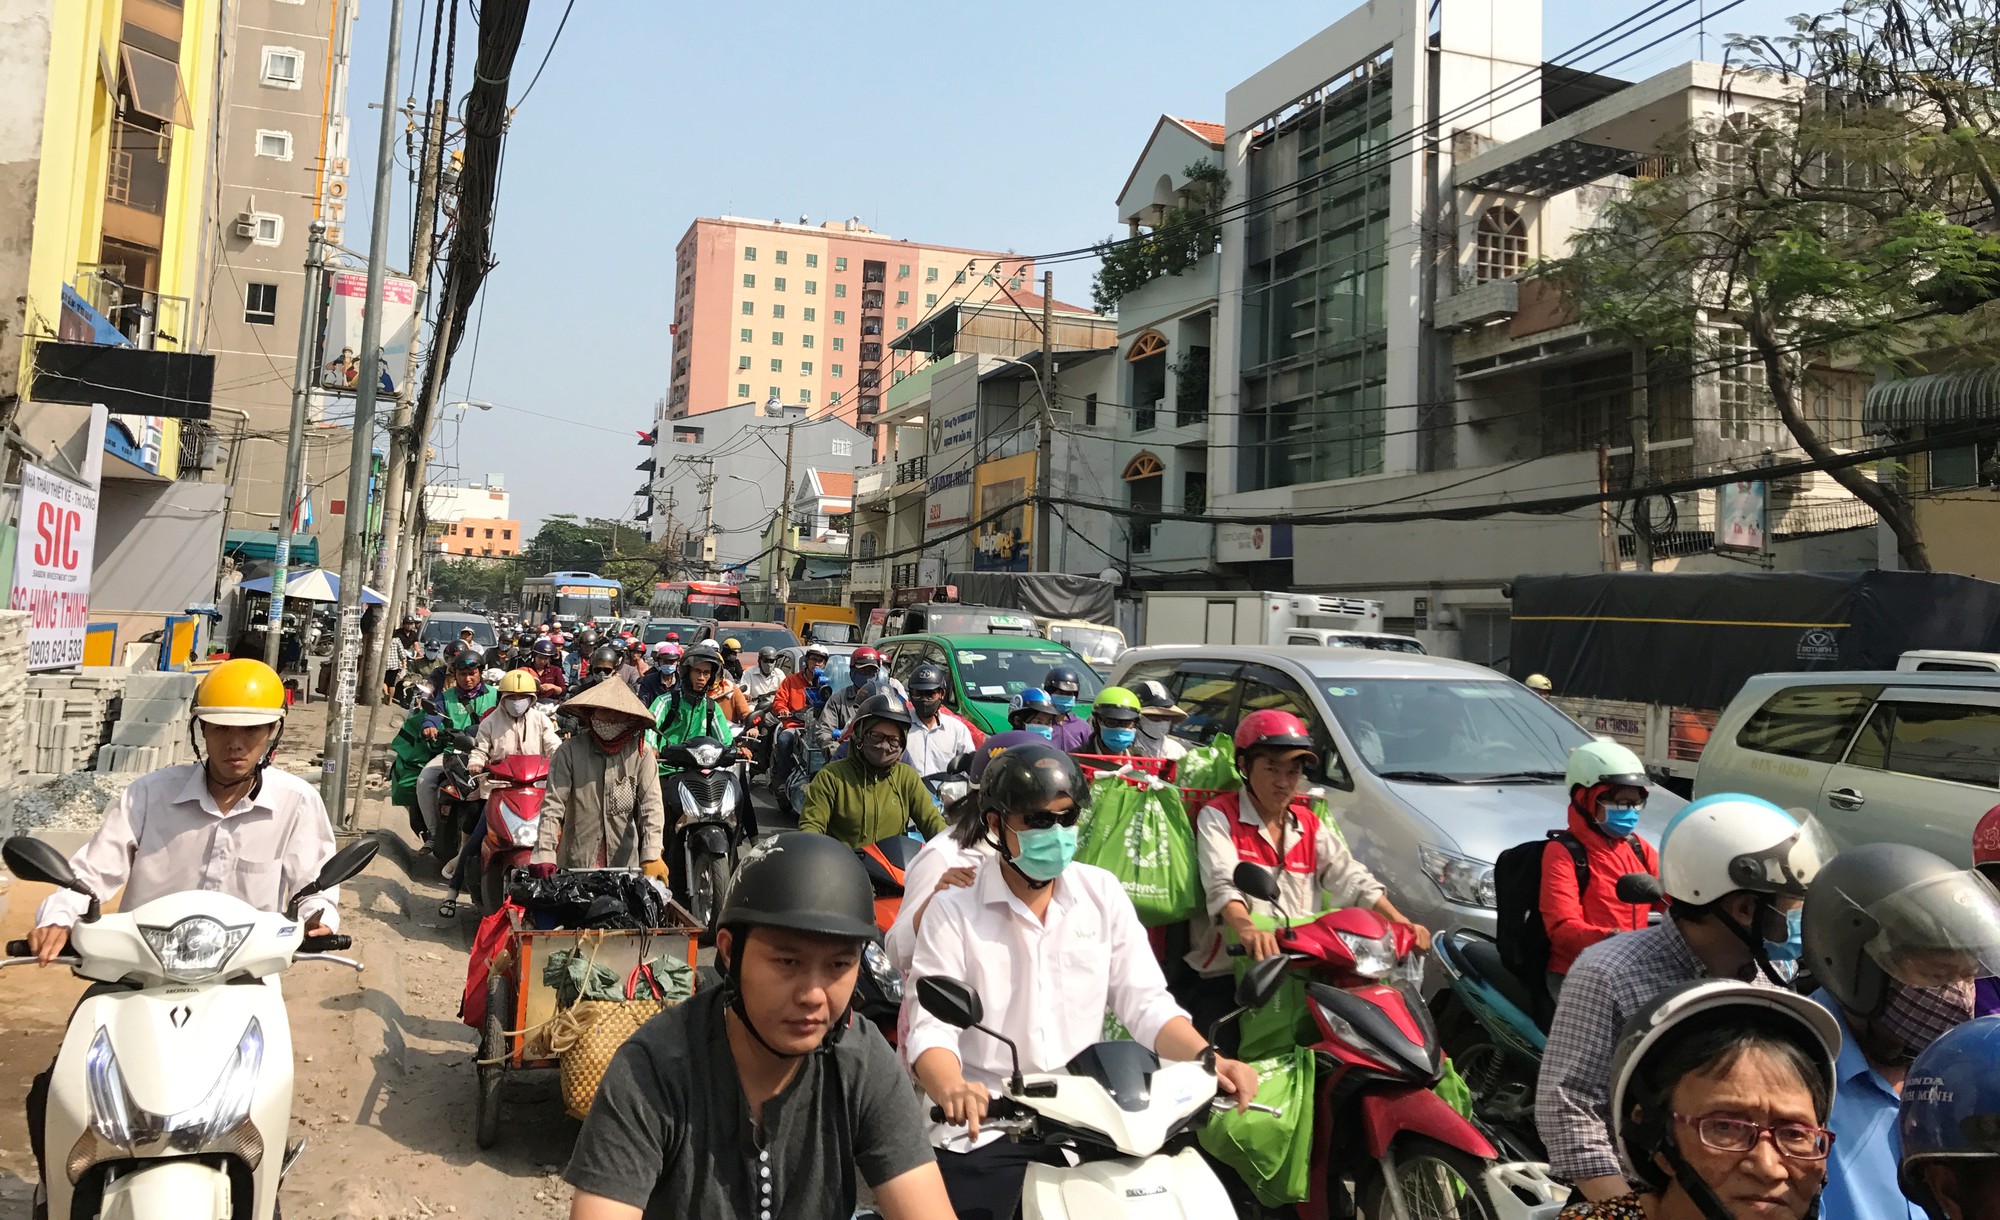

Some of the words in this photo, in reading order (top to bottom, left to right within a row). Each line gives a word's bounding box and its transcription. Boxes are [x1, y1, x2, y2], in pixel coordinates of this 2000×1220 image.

[34, 501, 81, 571] SIC
[32, 569, 46, 579] SAIGON
[46, 572, 68, 582] INVESTMENT
[993, 616, 1020, 626] TAXI
[29, 640, 50, 666] 0903
[51, 639, 67, 664] 624
[67, 638, 83, 663] 533
[165, 987, 200, 995] HONDA
